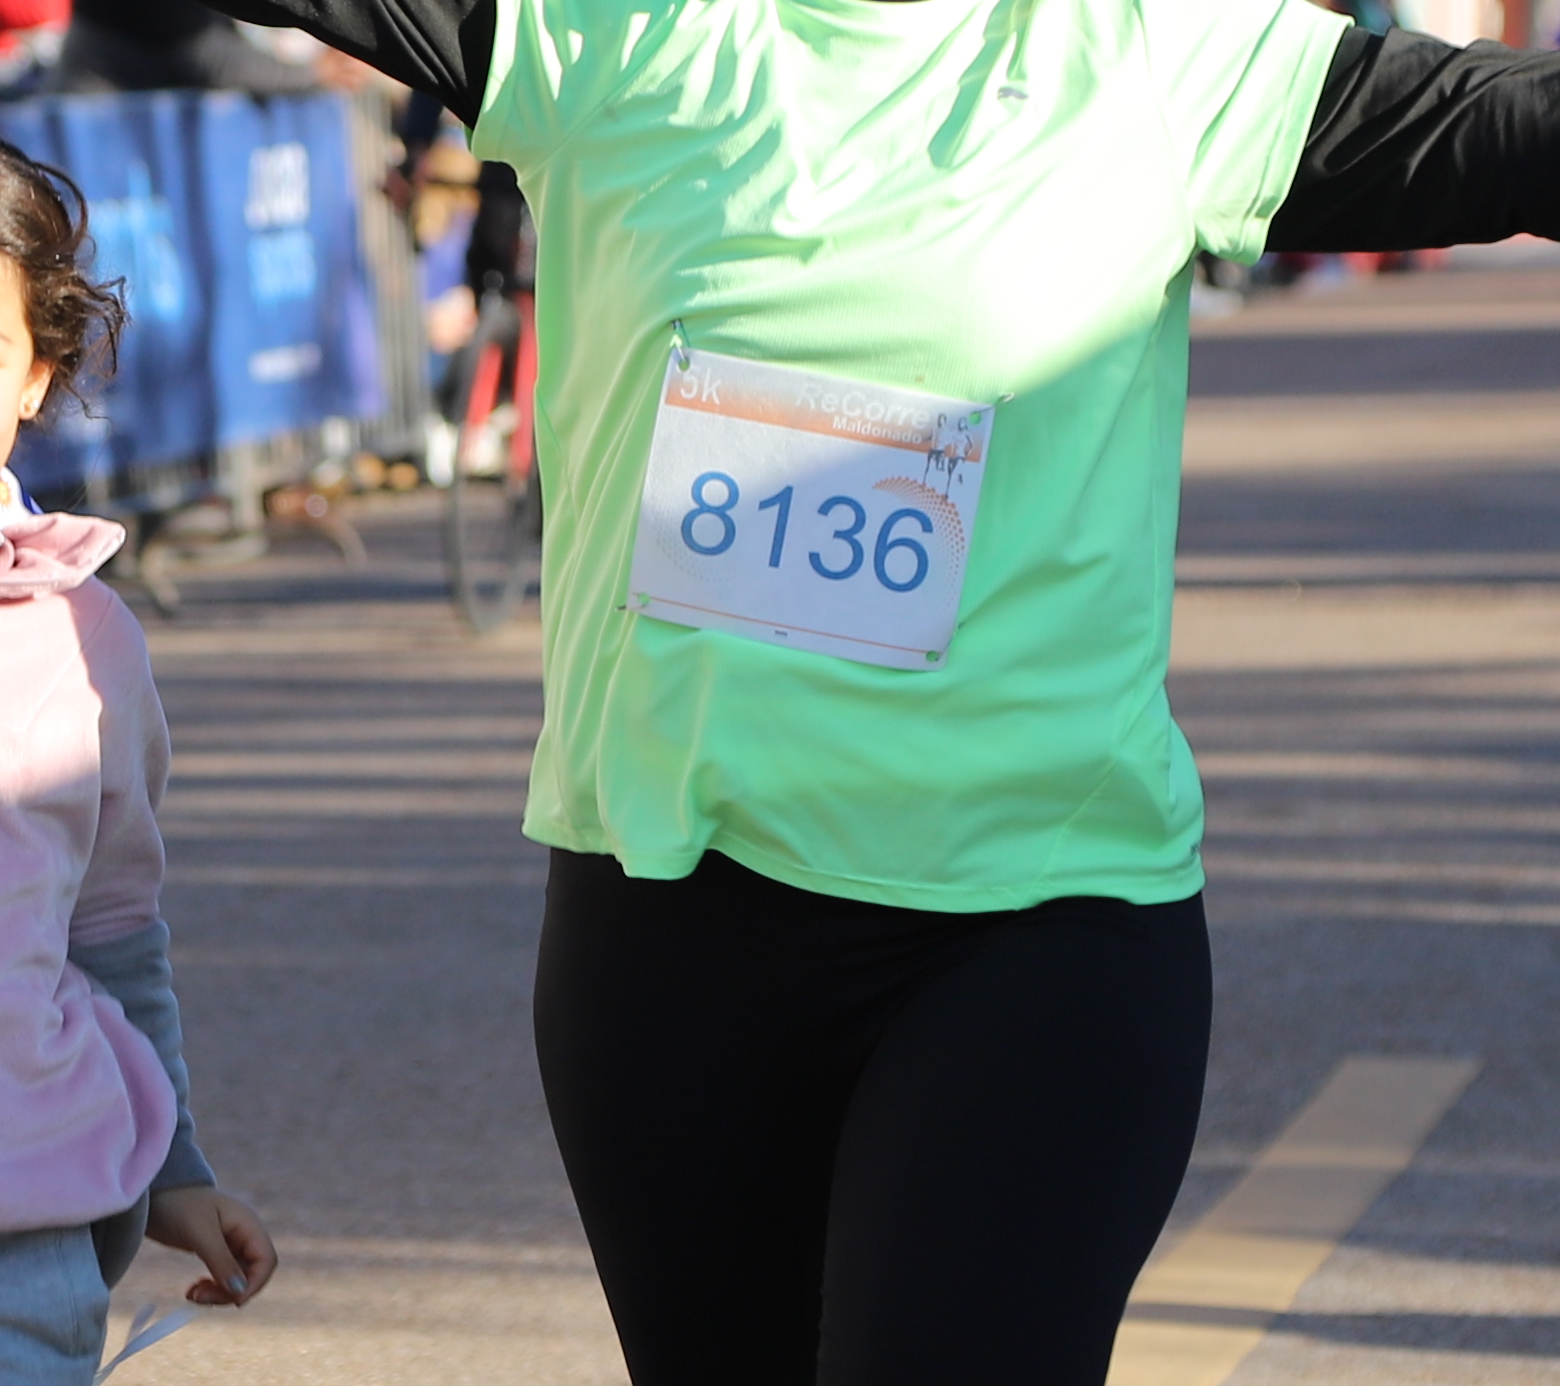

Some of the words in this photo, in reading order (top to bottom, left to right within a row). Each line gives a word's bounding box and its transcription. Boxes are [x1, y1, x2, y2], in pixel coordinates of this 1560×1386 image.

[678, 365, 722, 406] 5k
[795, 381, 931, 430] ReCorre
[832, 415, 922, 445] Maldonado
[680, 470, 934, 593] 8136
